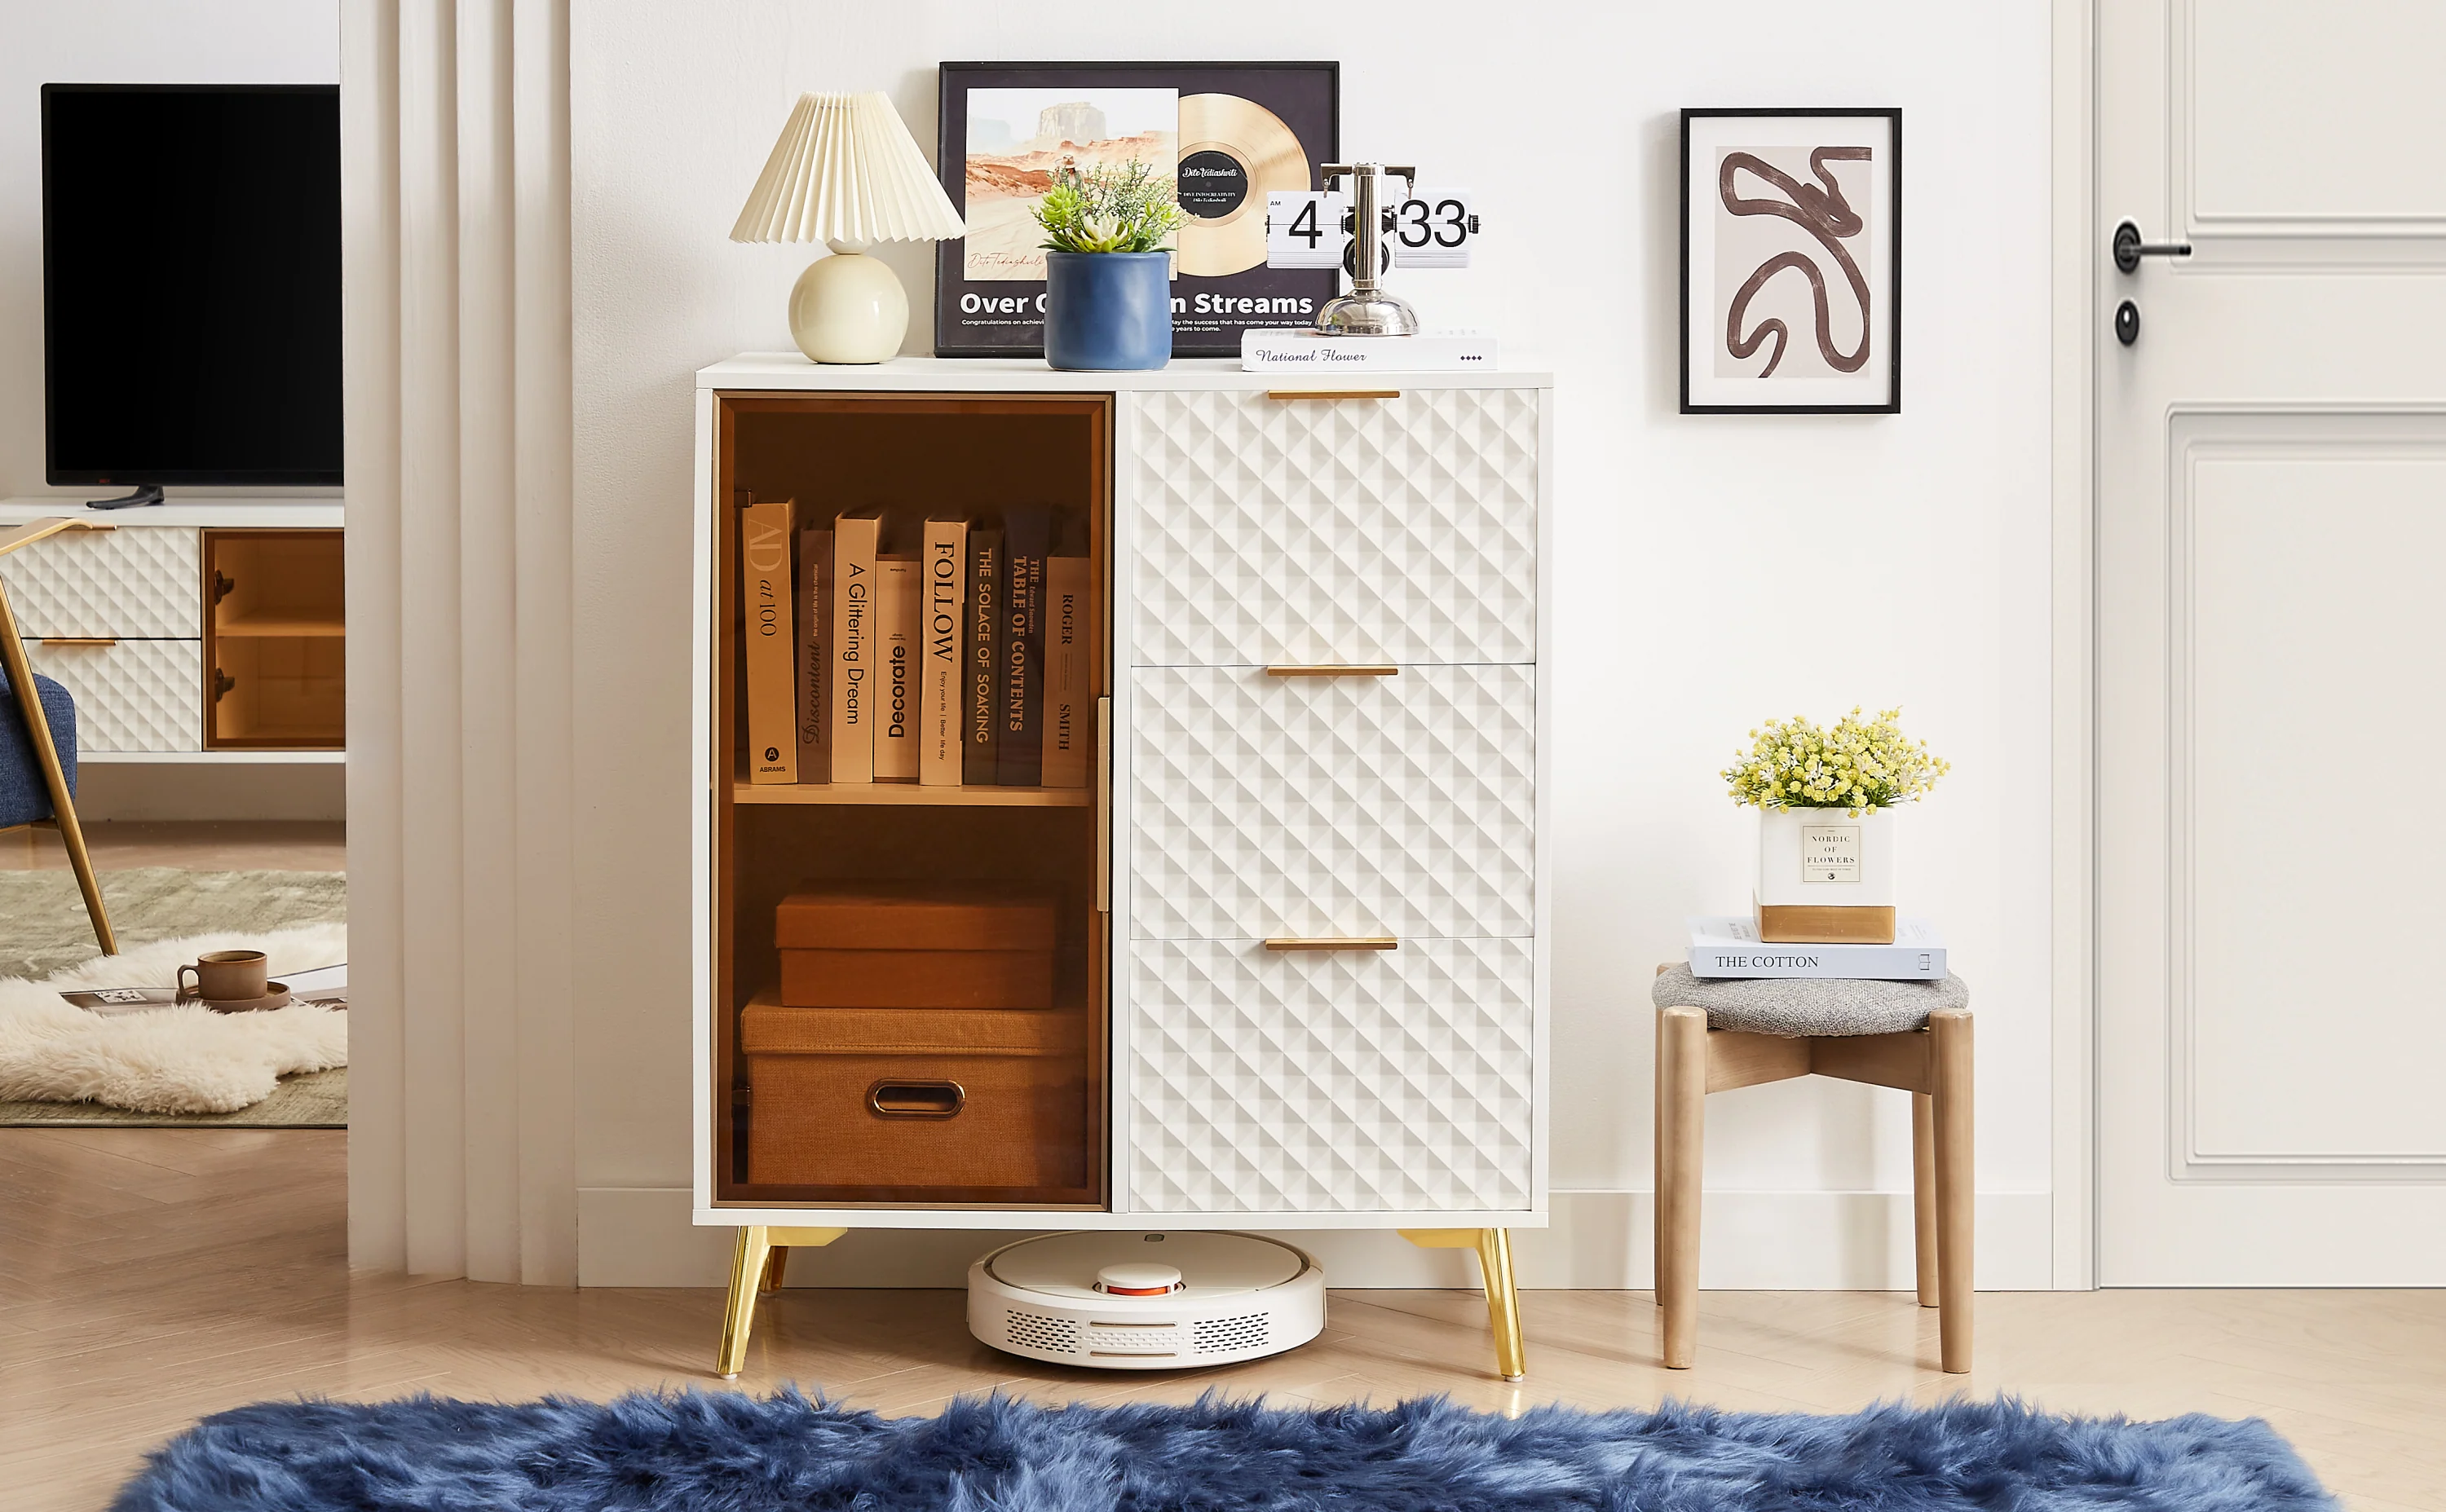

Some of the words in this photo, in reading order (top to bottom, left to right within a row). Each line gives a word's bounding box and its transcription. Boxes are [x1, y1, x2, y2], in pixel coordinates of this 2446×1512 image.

[1288, 200, 1322, 249] 4
[1398, 199, 1467, 248] 33
[960, 293, 1029, 314] Over
[1194, 293, 1314, 314] Streams
[1256, 349, 1317, 362] National
[1321, 349, 1367, 362] Flower
[748, 518, 783, 571] AD
[978, 548, 992, 577] THE
[759, 579, 774, 599] at
[849, 562, 866, 578] A
[1013, 555, 1027, 608] TABLE
[1030, 559, 1040, 583] THE
[760, 602, 777, 637] 100
[842, 583, 868, 662] Glittering
[933, 541, 955, 663] FOLLOW
[978, 583, 991, 641] SOLACE
[1012, 613, 1026, 637] OF
[1062, 593, 1074, 646] ROGER
[978, 647, 990, 668] OF
[802, 641, 820, 744] Discontent
[847, 668, 864, 725] Dream
[888, 646, 906, 738] Decorate
[975, 674, 989, 743] SOAKING
[1009, 641, 1025, 731] CONTENTS
[1058, 703, 1071, 751] SMITH
[1715, 956, 1747, 968] THE
[1752, 955, 1819, 968] COTTON
